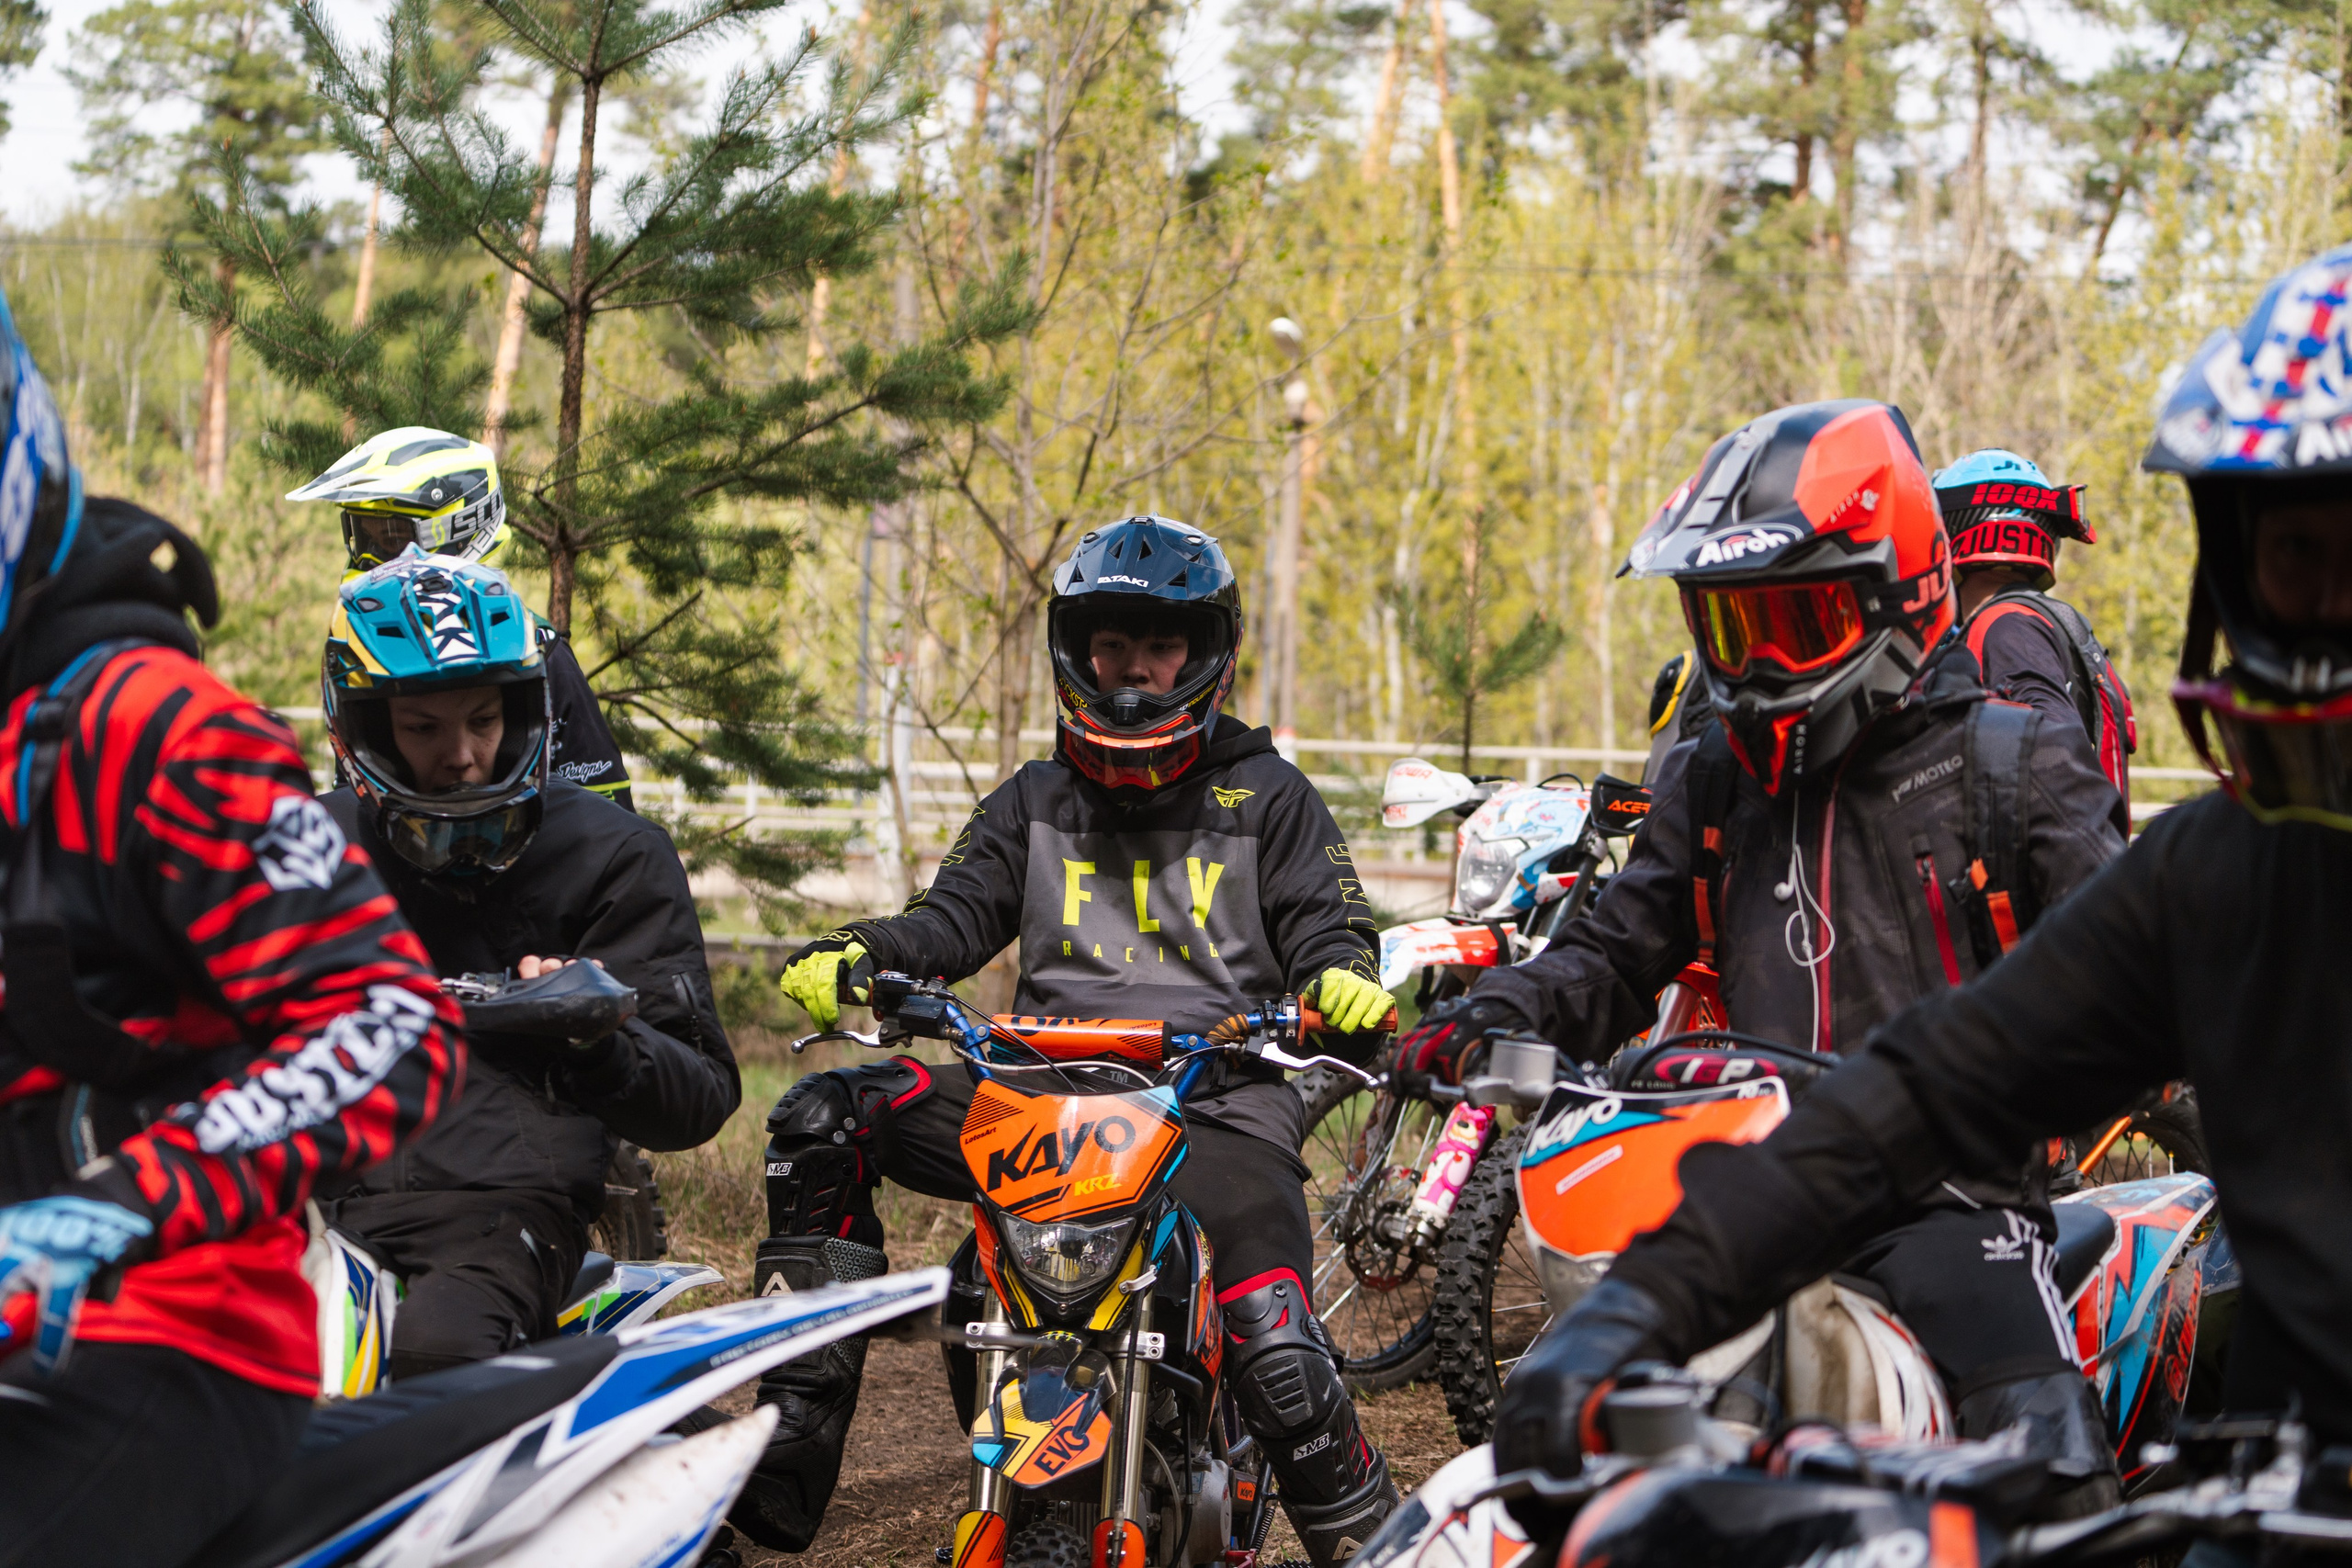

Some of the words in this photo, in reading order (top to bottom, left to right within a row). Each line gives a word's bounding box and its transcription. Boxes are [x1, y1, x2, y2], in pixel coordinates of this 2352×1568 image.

[1695, 528, 1791, 567] Airoh
[1061, 856, 1225, 933] FLY
[1062, 939, 1219, 963] RACING
[965, 1126, 997, 1145] LotosArt
[1073, 1172, 1122, 1196] KRZ
[1034, 1425, 1091, 1476] EVO
